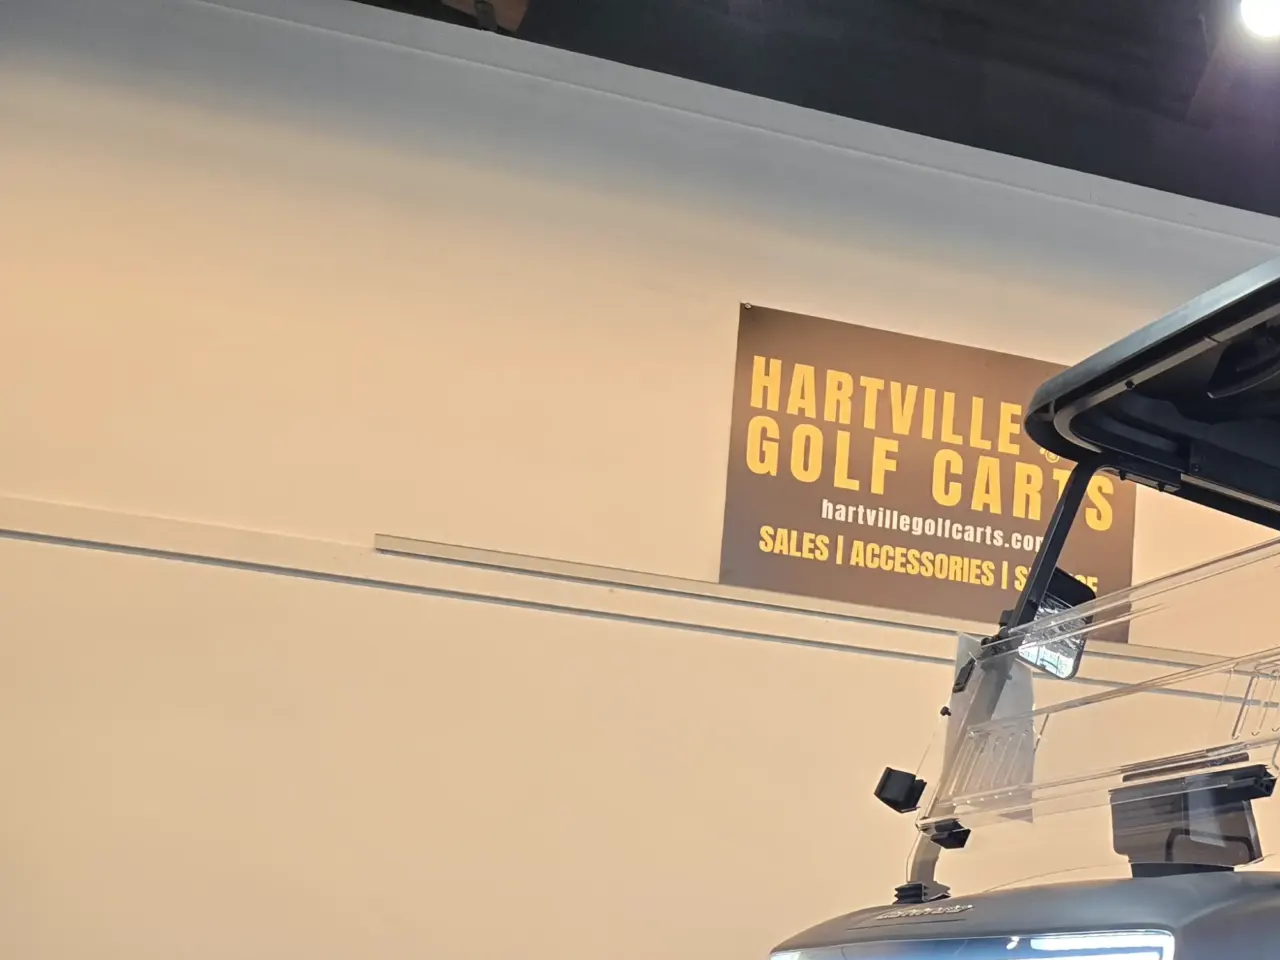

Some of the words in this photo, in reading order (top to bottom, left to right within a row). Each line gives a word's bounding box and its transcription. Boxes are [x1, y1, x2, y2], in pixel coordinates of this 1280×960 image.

[749, 355, 1023, 456] HARTVILLE
[746, 415, 900, 496] GOLF
[759, 525, 830, 562] SALES
[849, 540, 996, 587] ACCESSORIES
